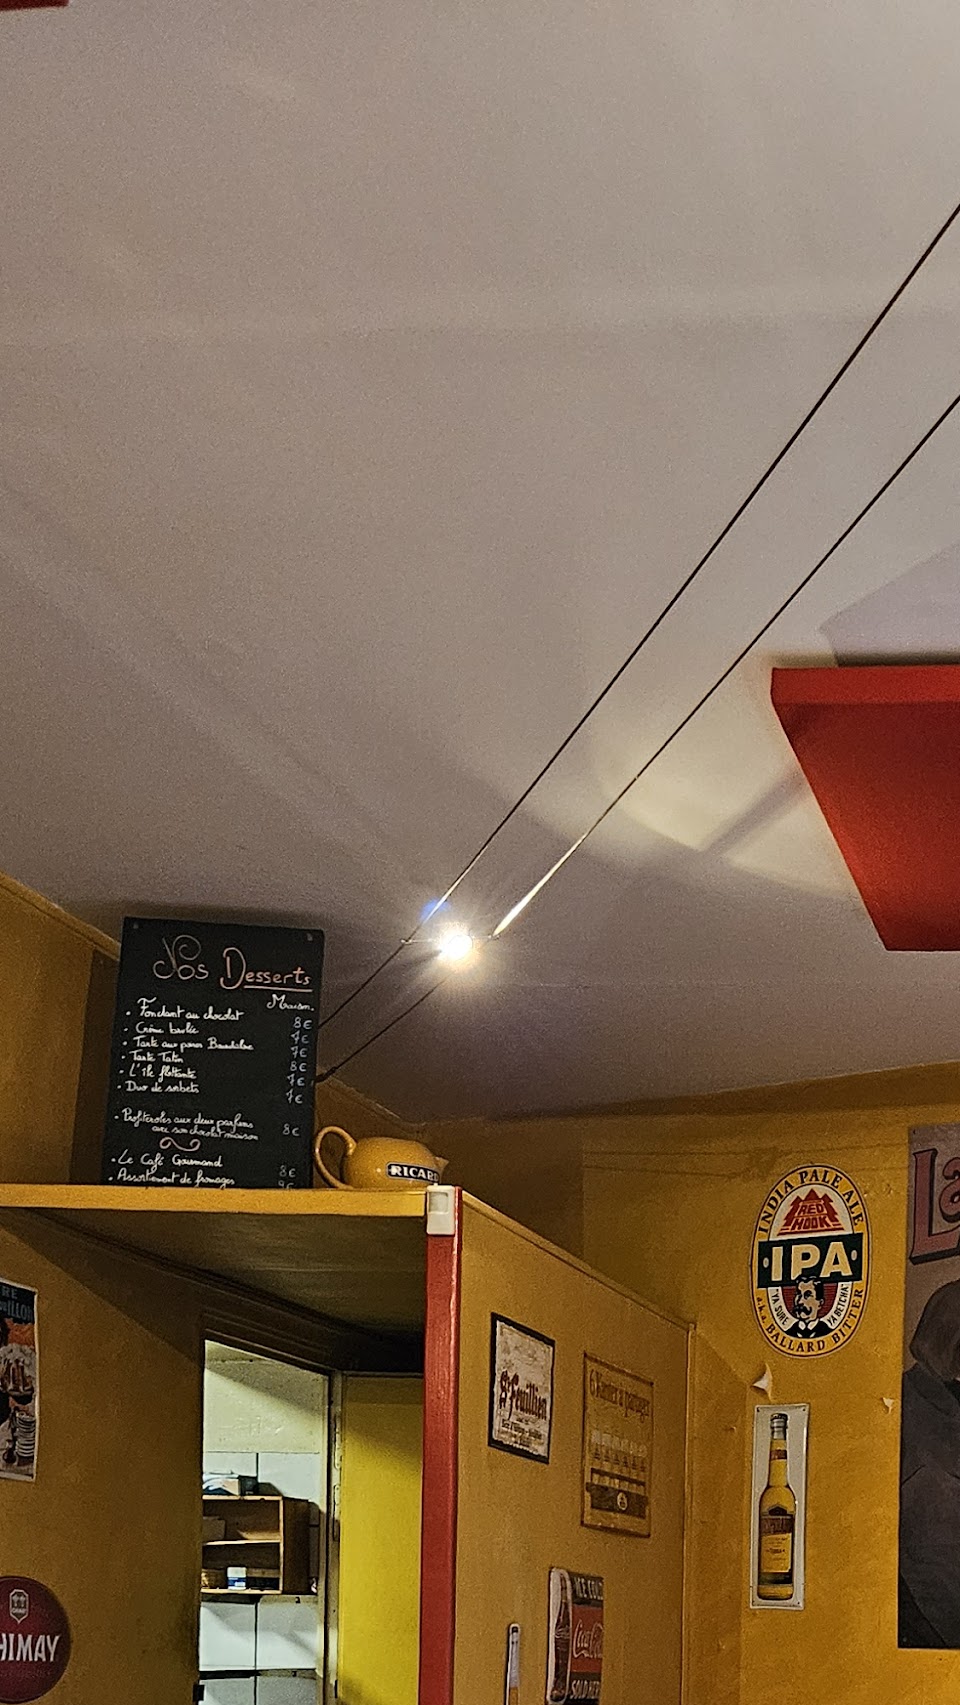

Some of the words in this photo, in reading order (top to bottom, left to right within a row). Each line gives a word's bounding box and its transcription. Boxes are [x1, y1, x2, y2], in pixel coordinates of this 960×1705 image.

[153, 934, 210, 980] Nos
[220, 947, 312, 989] Desserts
[137, 997, 185, 1018] Fondant
[185, 1011, 200, 1019] au
[203, 1005, 244, 1020] chocolat
[133, 1035, 159, 1048] Tarte
[129, 1049, 156, 1062] Tarte
[158, 1050, 183, 1063] Tatin
[158, 1065, 197, 1082] flottante
[125, 1080, 148, 1091] Duo
[151, 1082, 162, 1092] de
[164, 1080, 199, 1093] sorbets
[121, 1107, 172, 1127] Profiteroles
[174, 1116, 191, 1124] aux
[193, 1113, 214, 1125] deux
[216, 1113, 254, 1133] parfums
[171, 1126, 188, 1134] son
[189, 1125, 223, 1138] chocolat
[224, 1132, 259, 1141] maison
[118, 1149, 134, 1164] Le
[140, 1152, 164, 1172] Café
[172, 1154, 223, 1168] Gourmand
[117, 1167, 179, 1184] Assortiment
[180, 1172, 192, 1185] de
[193, 1169, 235, 1189] fromages
[391, 1165, 439, 1182] RICARD
[758, 1180, 795, 1234] INDIA
[799, 1170, 842, 1187] PALE
[843, 1191, 864, 1226] ALE
[800, 1203, 825, 1216] RED
[791, 1215, 831, 1231] HOOK
[771, 1241, 853, 1282] IPA
[766, 1324, 826, 1352] BALLARD
[832, 1289, 864, 1343] BITTER
